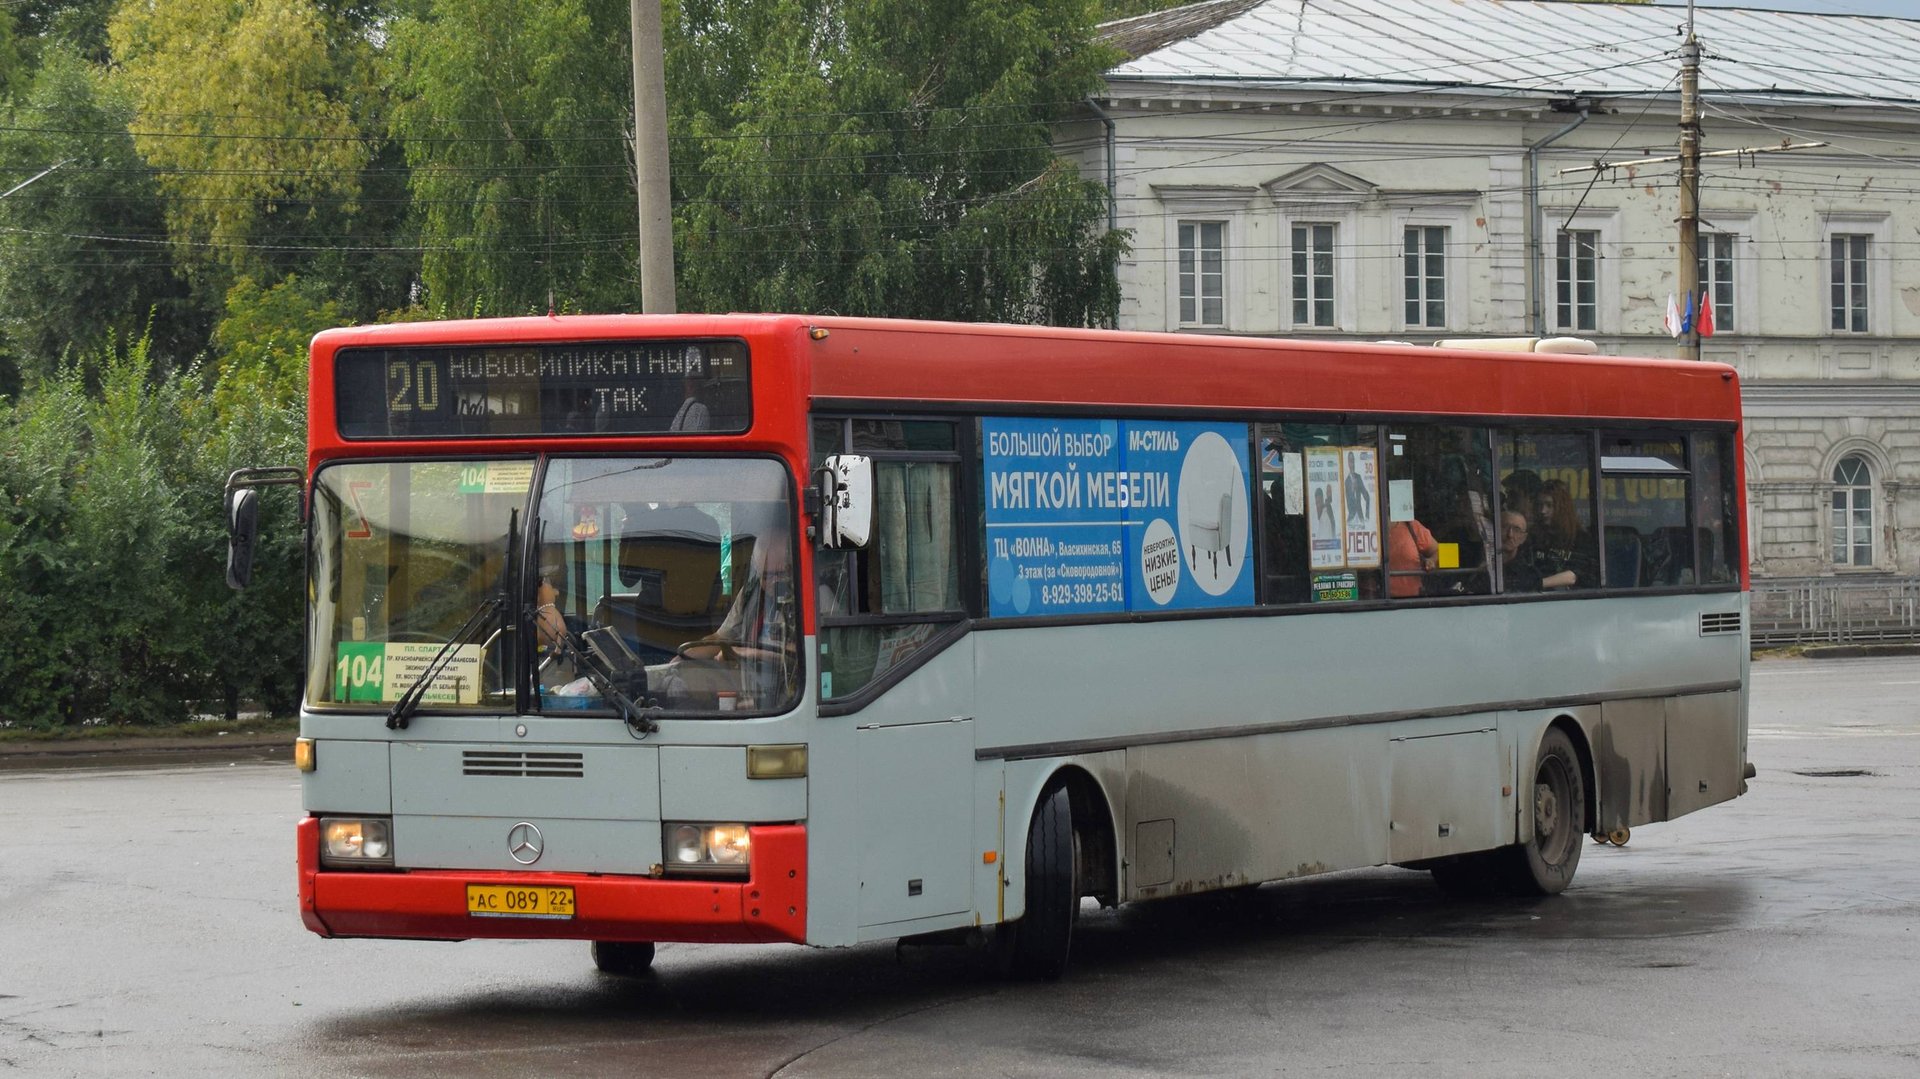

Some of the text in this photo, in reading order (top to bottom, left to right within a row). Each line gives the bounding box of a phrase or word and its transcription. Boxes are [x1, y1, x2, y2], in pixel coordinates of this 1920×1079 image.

[390, 361, 438, 411] 20
[596, 387, 647, 412] ТАК
[990, 428, 1111, 457] БОЛЬШОЙ ВЫБОР
[1130, 430, 1179, 451] М-СТИЛЬ
[461, 468, 486, 486] 104
[991, 463, 1170, 508] МЯГКОЙ МЕБЕЛИ
[994, 538, 1009, 560] ТЦ
[1059, 541, 1111, 557] Власихинская,
[1112, 541, 1121, 554] 65
[1144, 537, 1175, 555] НЕВЕРОЯТНО
[1019, 563, 1024, 577] 3
[1025, 566, 1042, 579] этаж
[1044, 564, 1055, 580] (за
[1145, 549, 1177, 573] НИЗКИЕ
[1149, 570, 1177, 593] ЦЕНЫ!
[1042, 582, 1124, 605] 8-929-398-25-61
[337, 654, 383, 688] 104
[477, 891, 567, 910] АС 089 22
